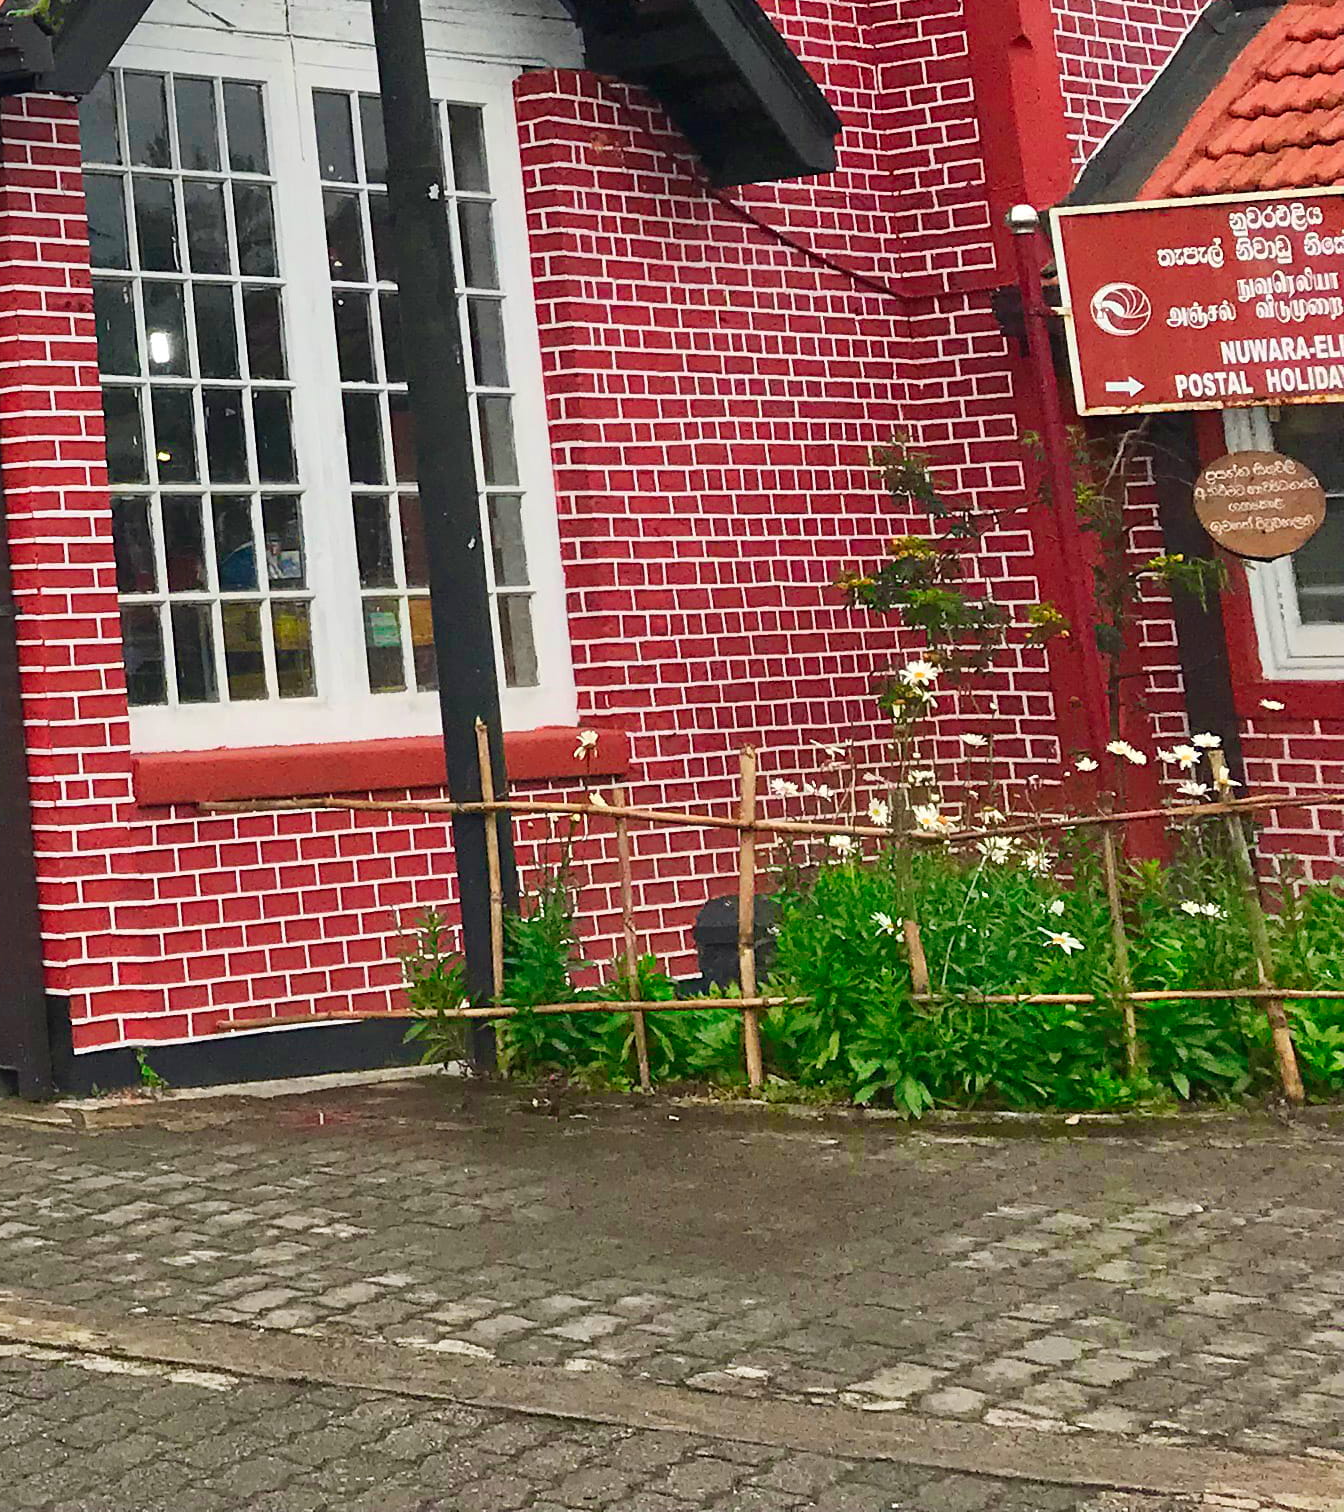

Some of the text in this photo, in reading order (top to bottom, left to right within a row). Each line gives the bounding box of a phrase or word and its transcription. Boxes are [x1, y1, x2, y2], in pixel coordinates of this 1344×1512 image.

[1158, 238, 1224, 267] තැපැල්
[1236, 234, 1292, 263] නිවාඩු
[1166, 300, 1236, 328] அஞ்சல்
[1175, 371, 1254, 398] POSTAL
